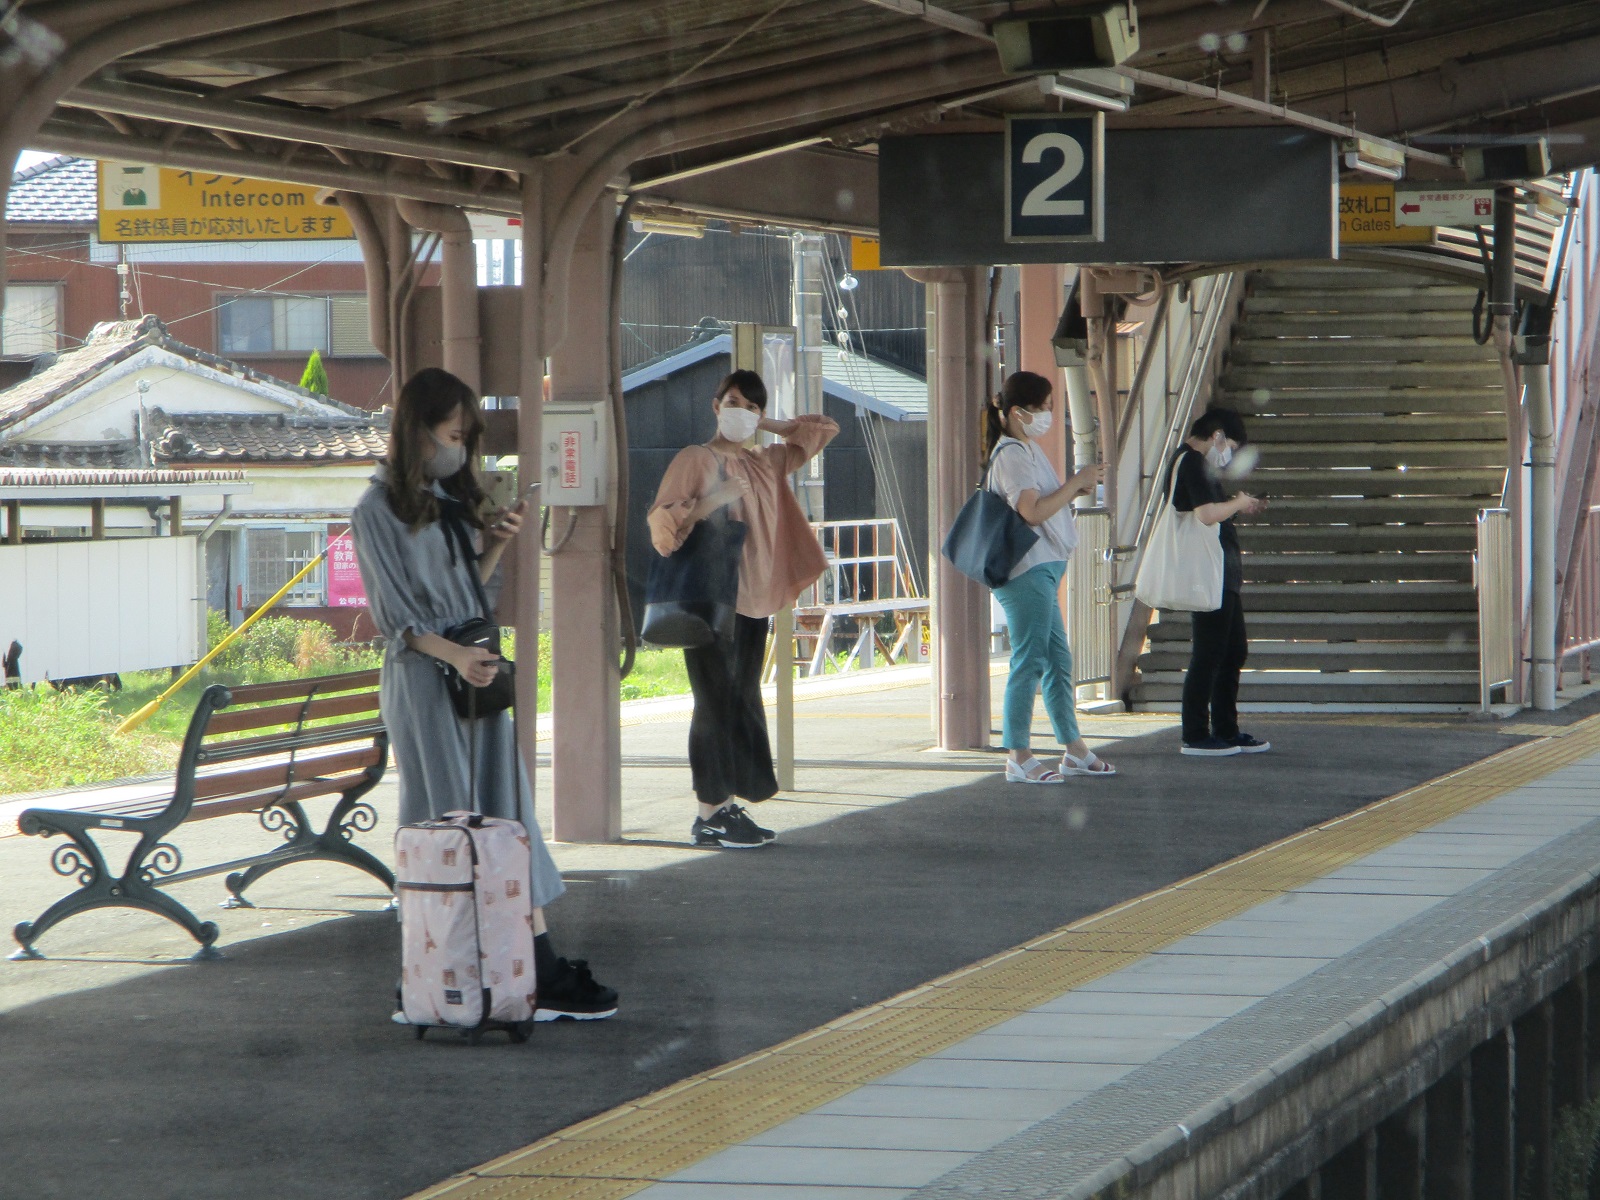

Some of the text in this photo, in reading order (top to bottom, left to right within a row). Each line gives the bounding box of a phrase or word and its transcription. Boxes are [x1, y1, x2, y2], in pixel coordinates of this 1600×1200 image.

[1021, 132, 1085, 216] 2
[202, 190, 305, 208] Intercom
[115, 216, 336, 237] 名鉄係員が応対いたします
[1351, 217, 1391, 231] Gates
[564, 436, 576, 483] 非常電話
